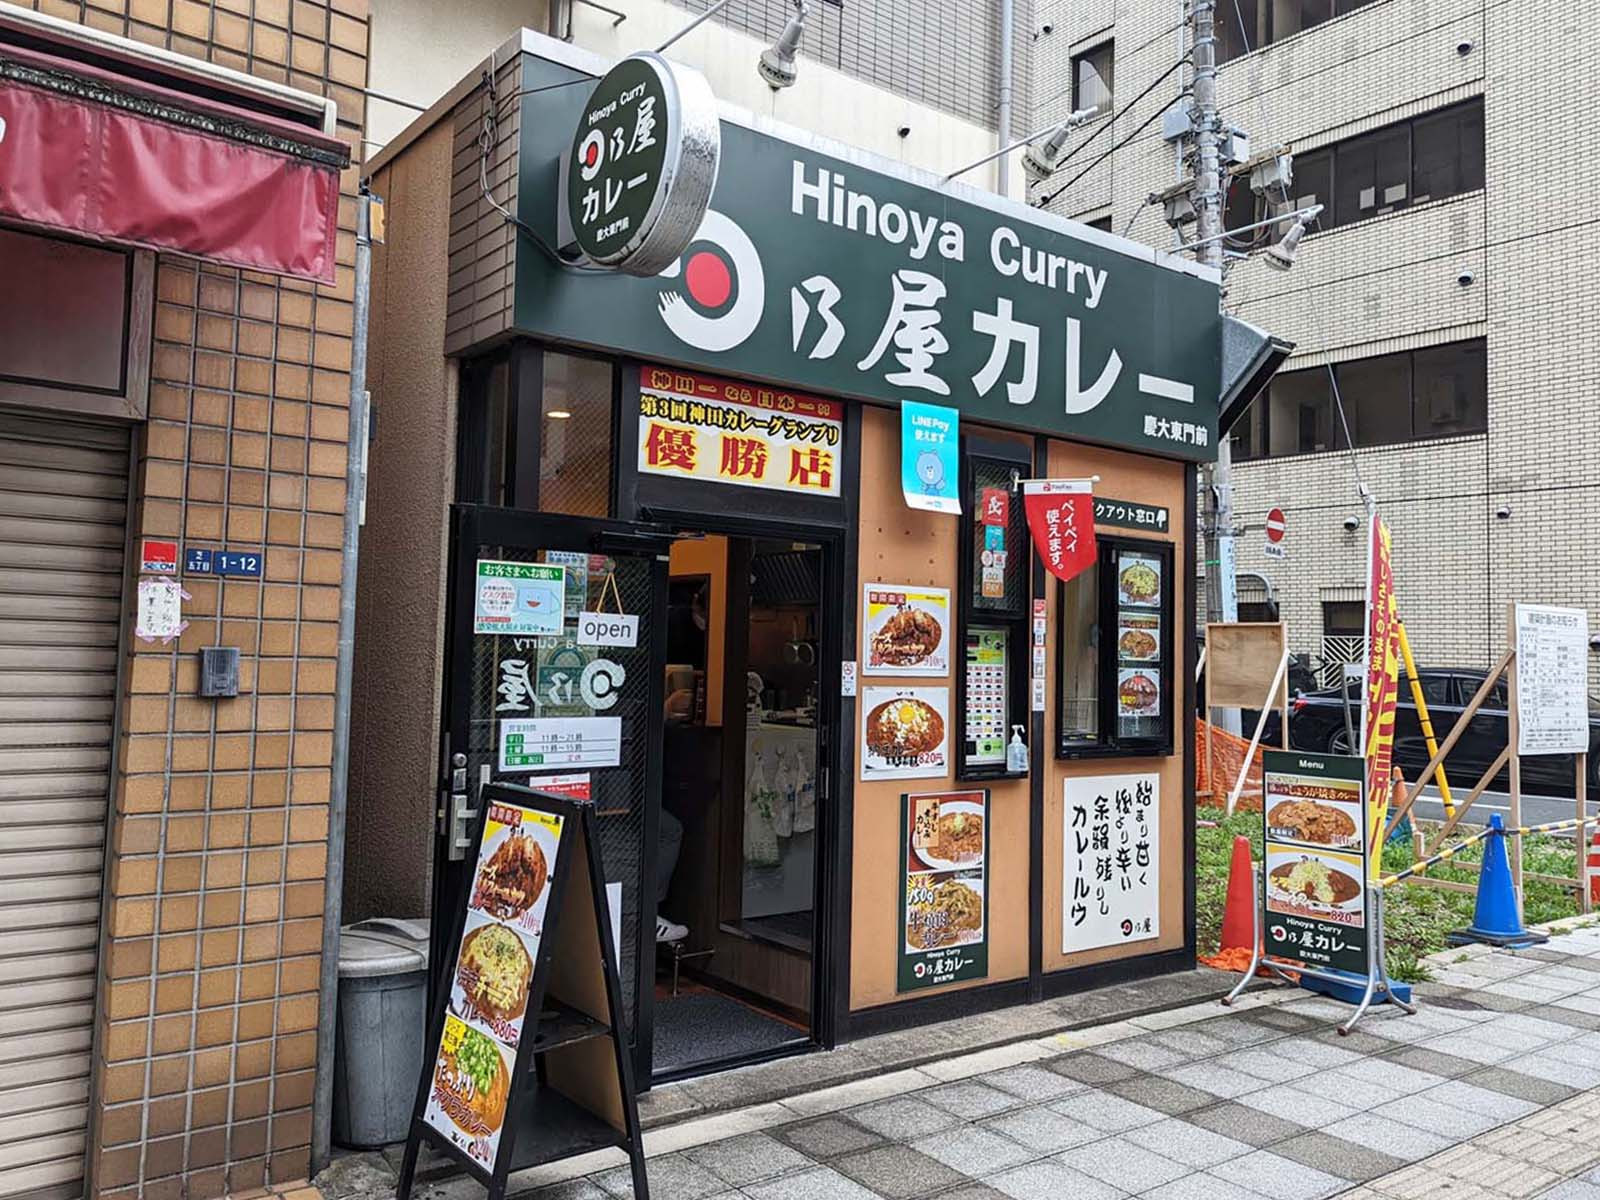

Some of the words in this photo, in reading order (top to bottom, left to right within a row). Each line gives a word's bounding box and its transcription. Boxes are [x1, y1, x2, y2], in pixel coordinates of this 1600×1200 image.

[588, 101, 617, 126] Hinoya
[620, 82, 647, 107] Curry
[582, 172, 648, 225] カレー
[792, 160, 965, 262] Hinoya
[990, 227, 1109, 308] Curry
[640, 393, 840, 446] 第3回神田カレーグランプリ
[915, 429, 946, 444] 使えます
[1143, 415, 1208, 447] 慶大東門前
[645, 422, 834, 489] 優勝店
[1061, 500, 1077, 553] ペイペイ
[1092, 502, 1155, 524] クアウト窓口
[221, 556, 257, 571] 1-12
[1046, 509, 1064, 570] 使えます。
[484, 564, 559, 579] お客さまへお願い
[584, 622, 631, 641] open
[1299, 759, 1324, 769] Menu
[1092, 795, 1113, 916] 余韻残りし
[1115, 788, 1132, 891] 後より辛い
[1071, 804, 1090, 926] カレールウ
[1286, 917, 1315, 930] Hinoya
[1318, 923, 1342, 935] Curry
